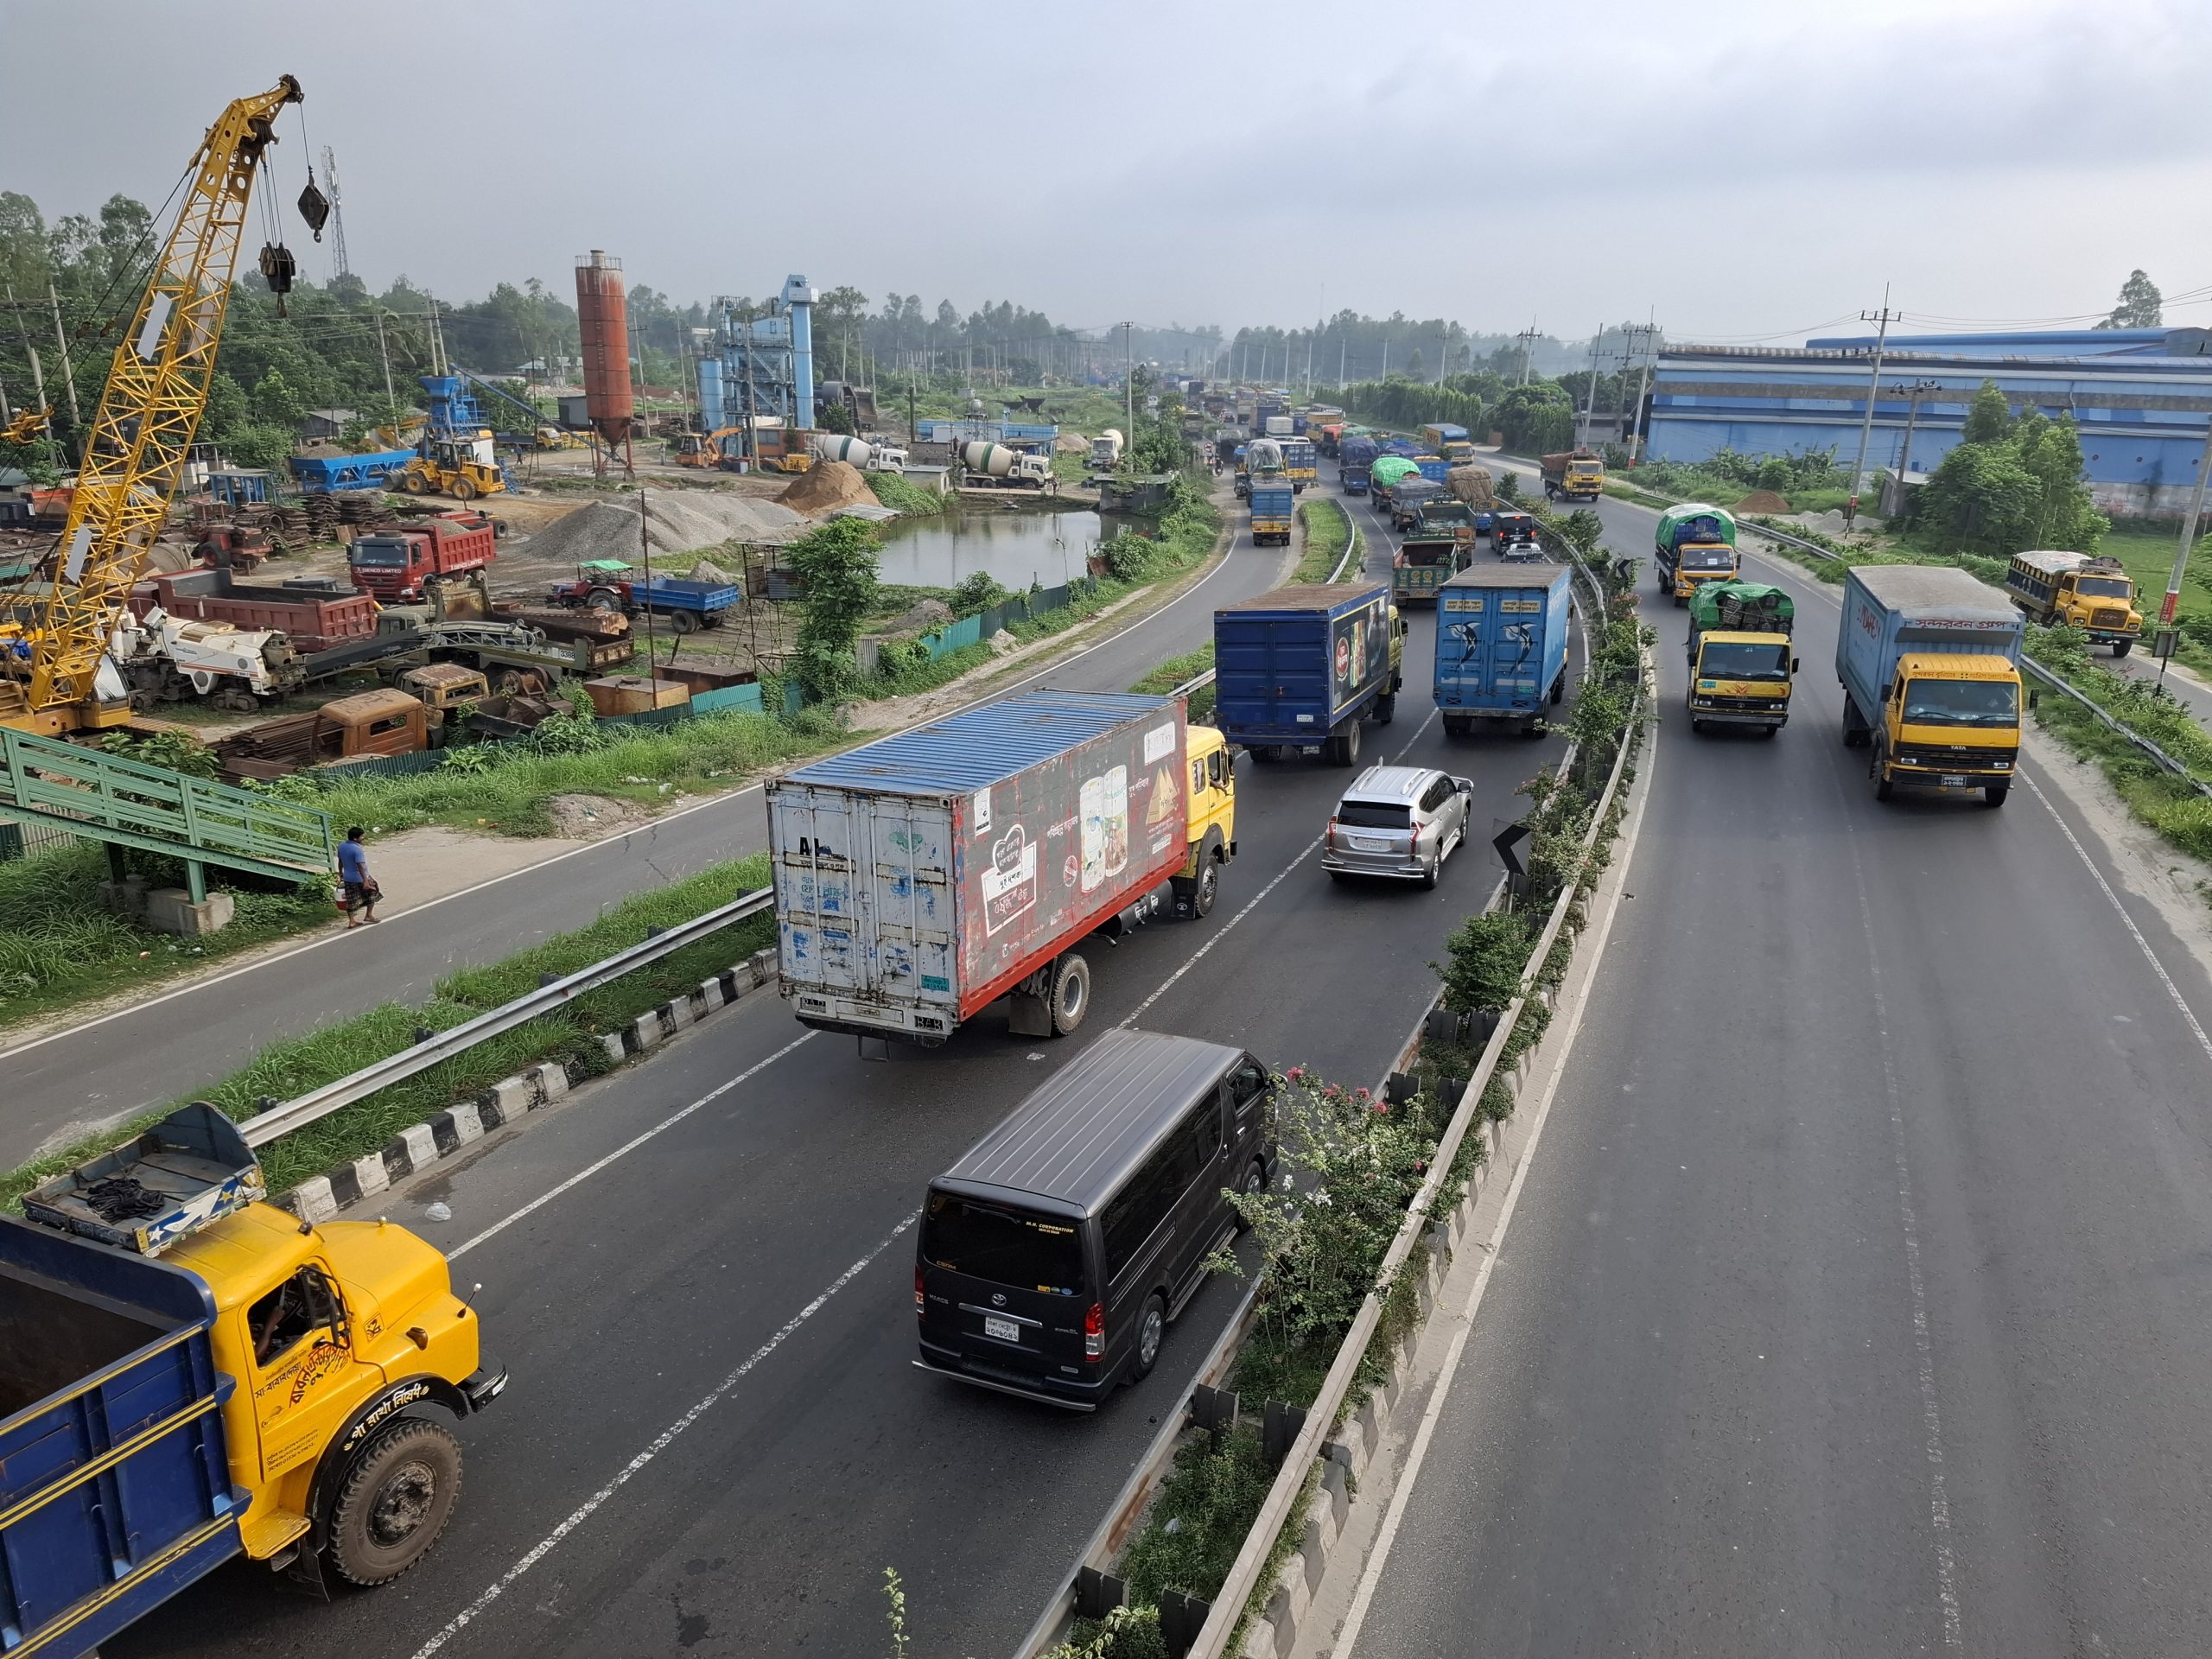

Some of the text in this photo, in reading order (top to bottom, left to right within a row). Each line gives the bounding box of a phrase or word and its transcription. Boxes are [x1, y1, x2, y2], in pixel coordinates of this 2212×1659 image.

[1915, 620, 1973, 629] সুন্দরবন
[1039, 1224, 1074, 1234] CORPORATION
[392, 1383, 423, 1408] নিষেধ
